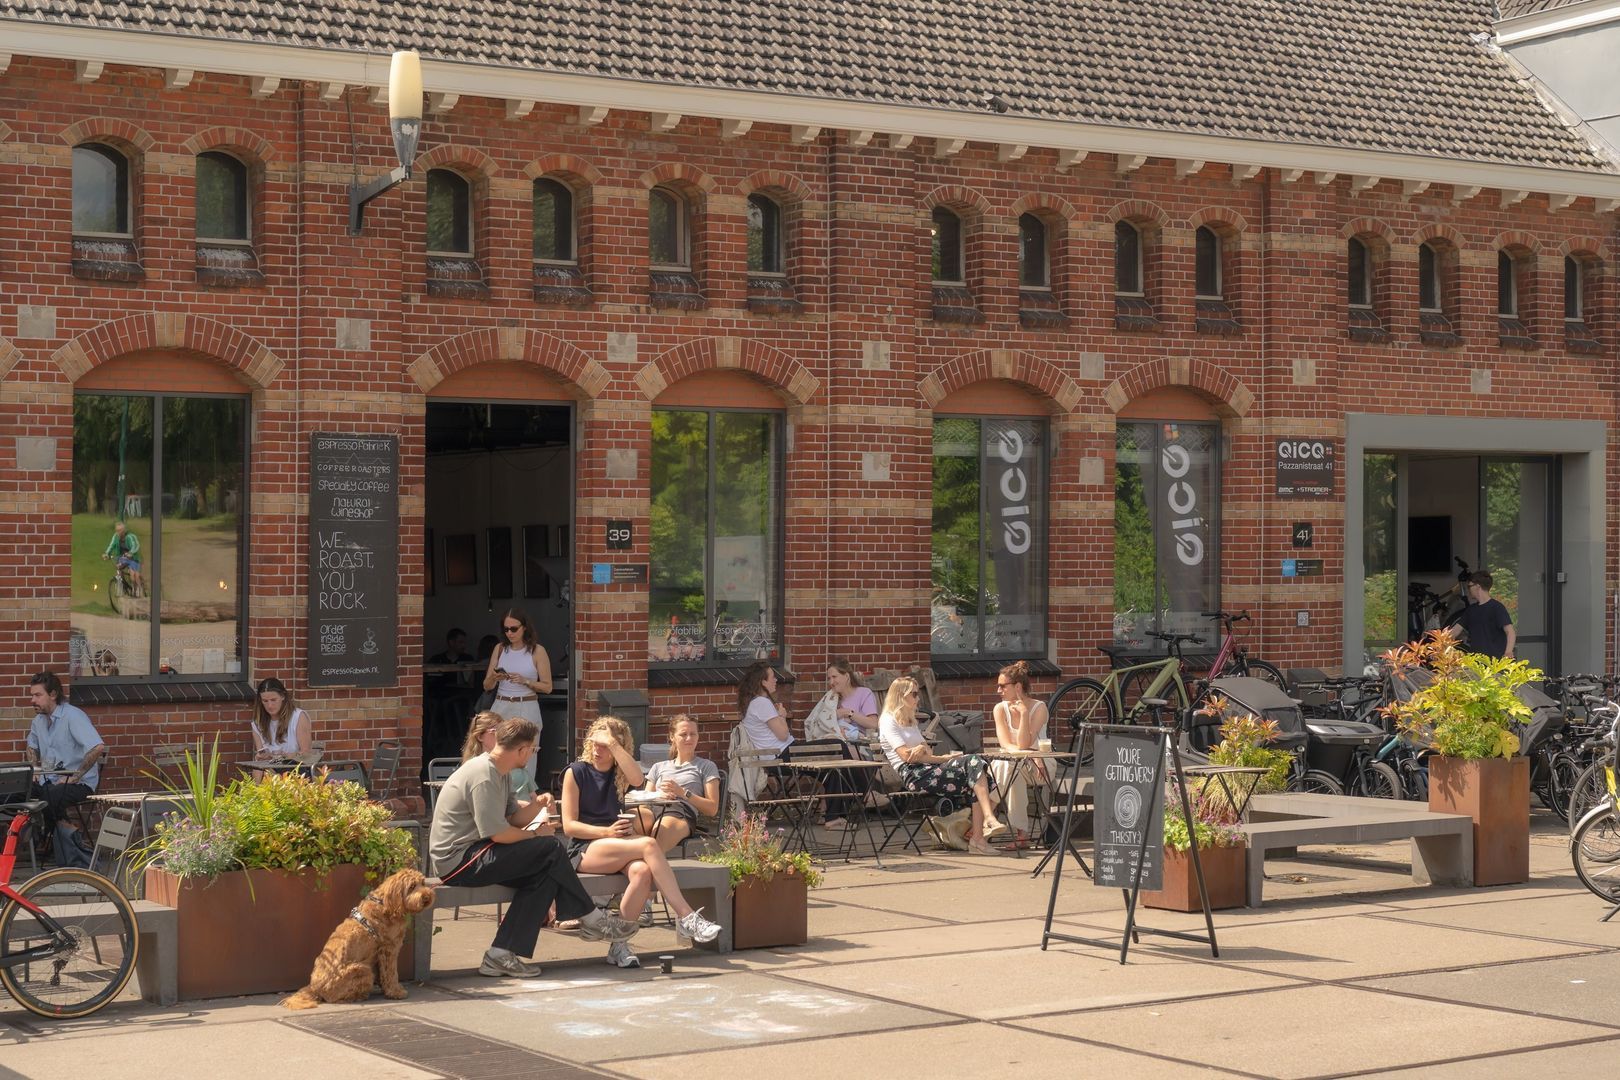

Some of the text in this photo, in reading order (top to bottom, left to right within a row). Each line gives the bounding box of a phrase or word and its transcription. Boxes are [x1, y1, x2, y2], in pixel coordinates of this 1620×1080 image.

[317, 463, 351, 472] COFFEE
[1278, 461, 1333, 471] Pazzanistraat 41
[318, 531, 344, 549] WE
[609, 529, 630, 541] 39
[1296, 529, 1309, 541] 41
[318, 571, 355, 590] YOU
[319, 591, 367, 610] ROCK.
[1105, 764, 1155, 784] GETTING VERY
